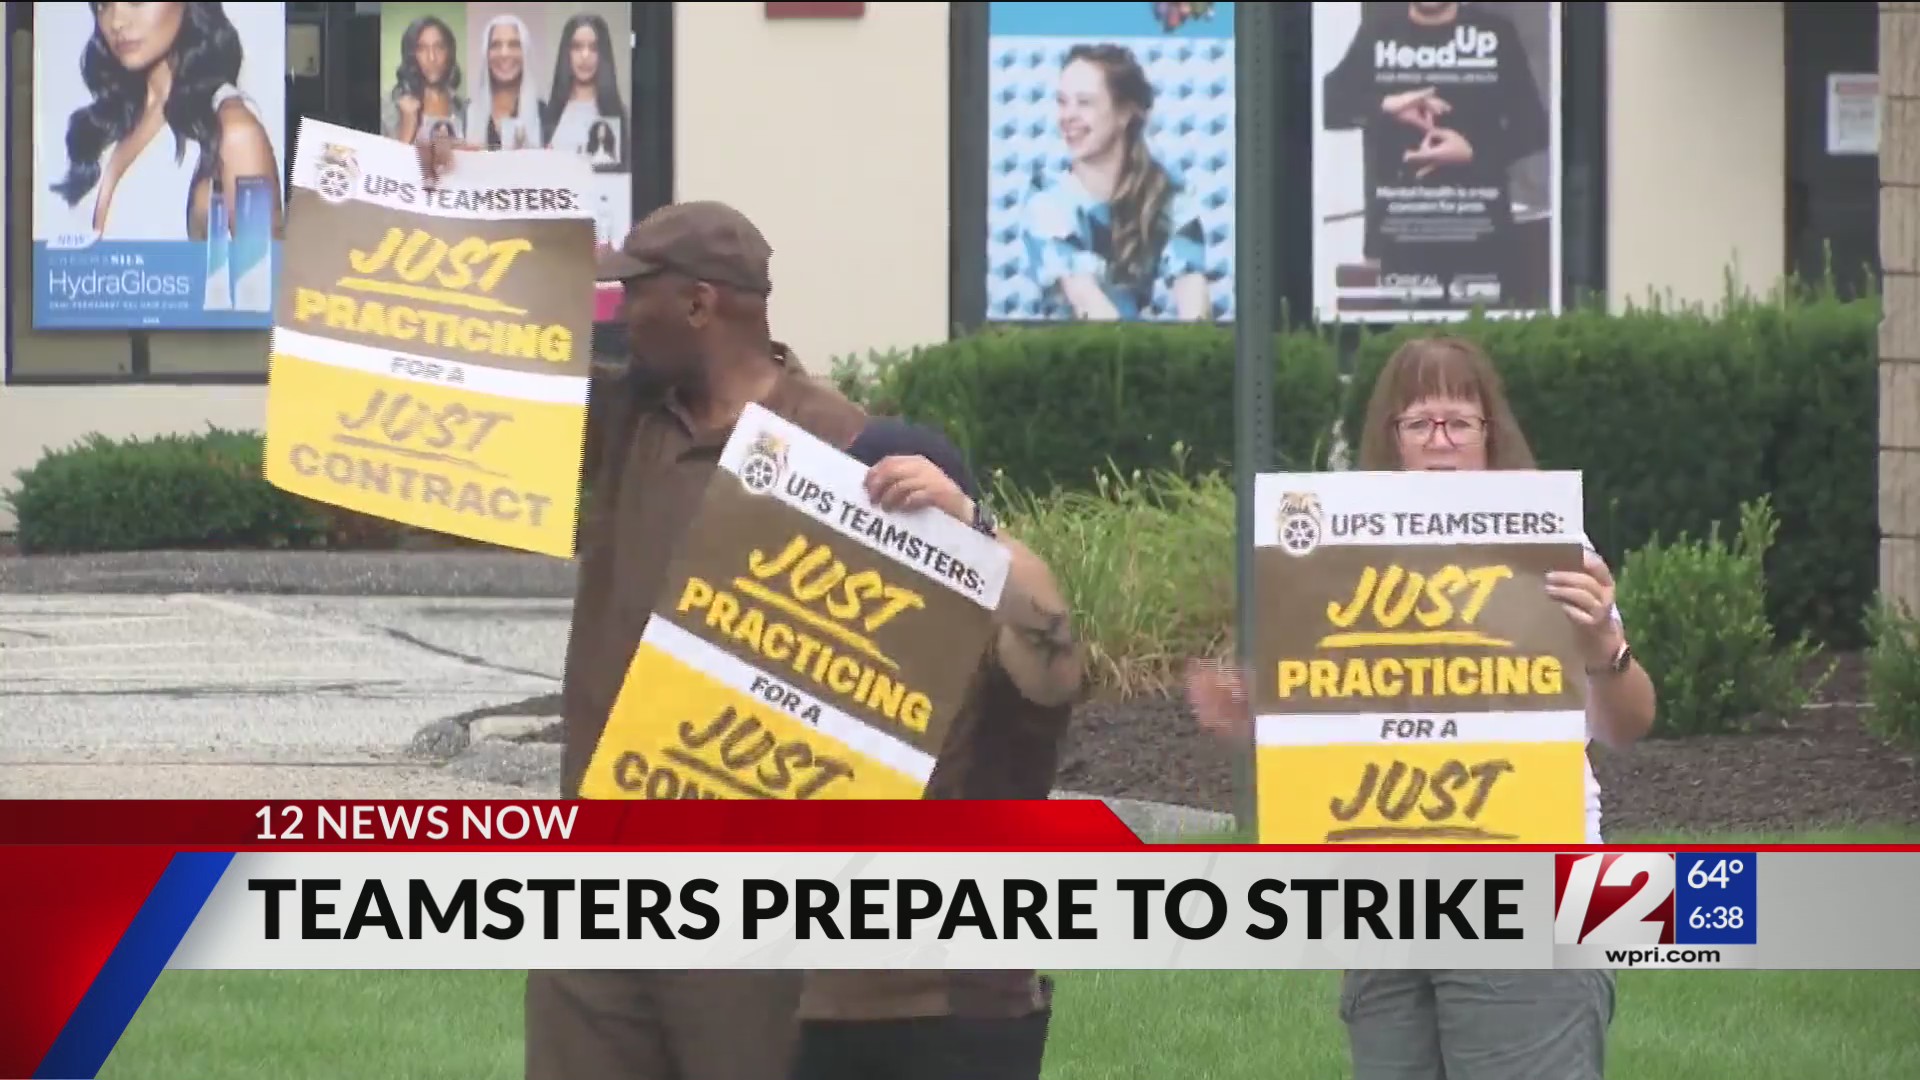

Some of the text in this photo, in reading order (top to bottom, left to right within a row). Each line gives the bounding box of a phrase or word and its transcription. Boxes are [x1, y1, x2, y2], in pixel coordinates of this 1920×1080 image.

[363, 174, 580, 211] UPS TEAMSTERS:
[49, 268, 189, 300] HydraGloss
[349, 227, 533, 292] JUST
[295, 288, 573, 362] PRACTICING
[391, 356, 465, 383] FOR A
[337, 389, 515, 452] JUST
[288, 443, 553, 527] CONTRACT
[785, 472, 986, 596] UPS TEAMSTERS:
[1331, 512, 1565, 536] UPS TEAMSTERS:
[749, 534, 926, 632] JUST
[1326, 564, 1514, 628] JUST
[677, 577, 933, 734] PRACTICING
[1277, 656, 1562, 698] PRACTICING
[749, 675, 822, 727] FOR A
[1380, 718, 1458, 739] FOR A
[678, 705, 855, 798] JUST
[1329, 759, 1515, 822] JUST
